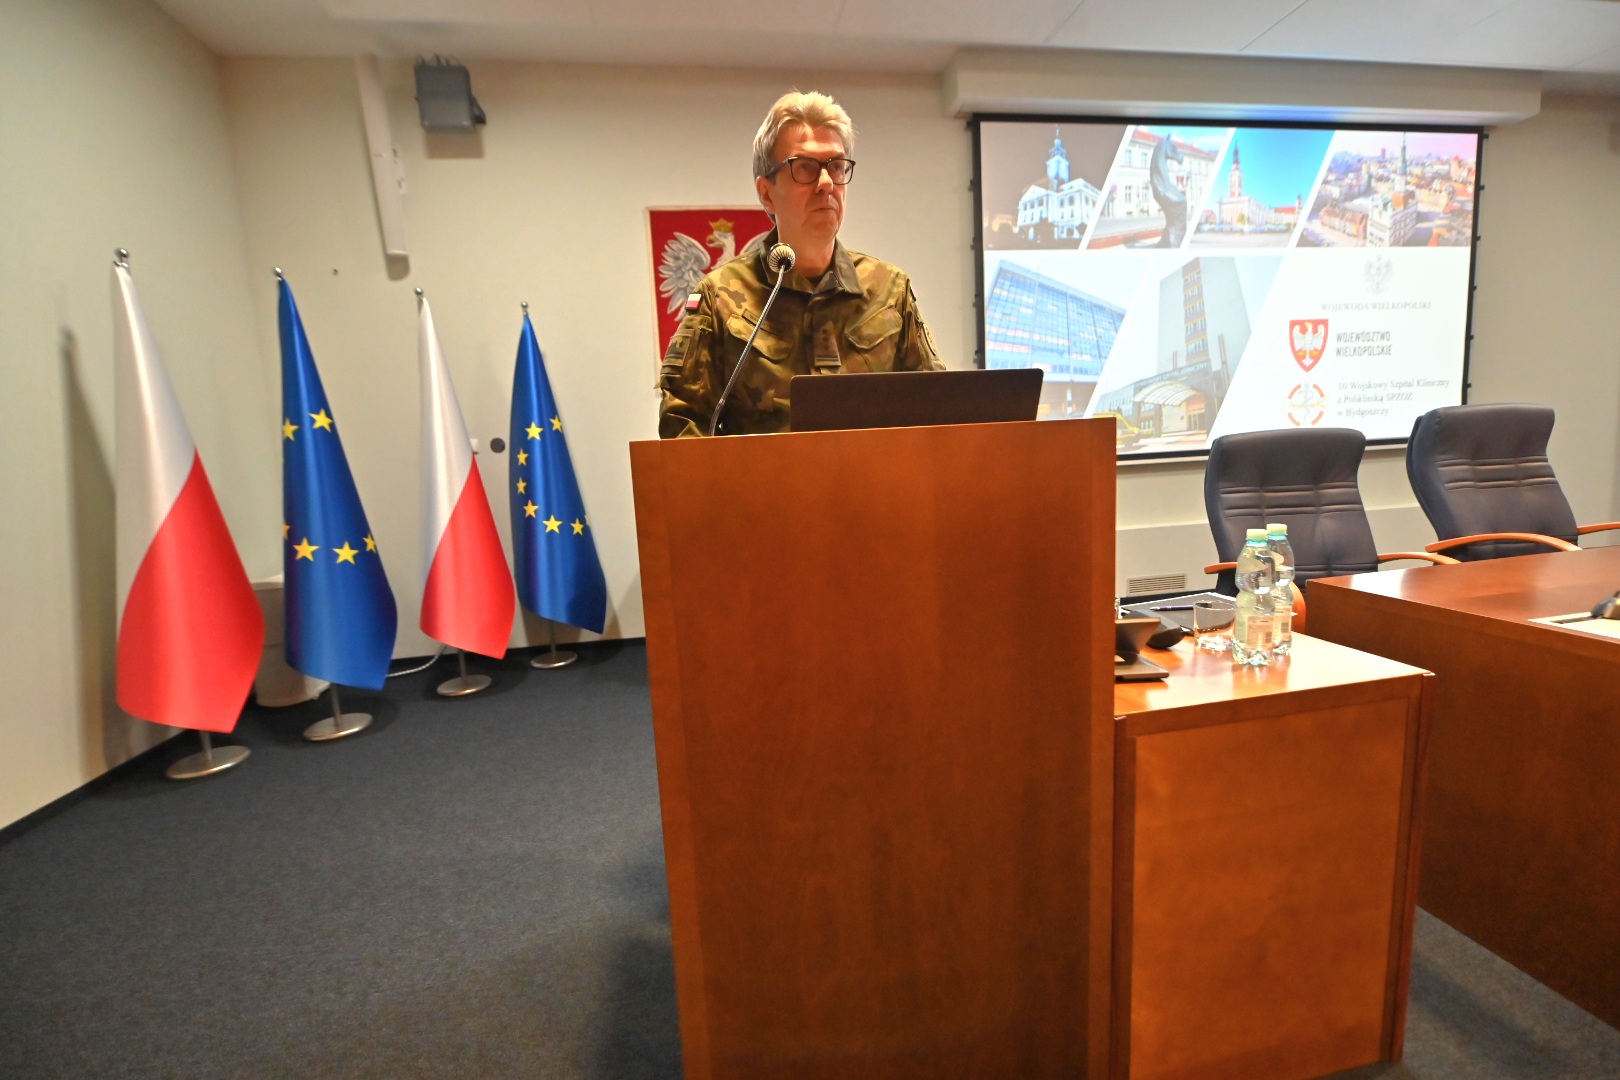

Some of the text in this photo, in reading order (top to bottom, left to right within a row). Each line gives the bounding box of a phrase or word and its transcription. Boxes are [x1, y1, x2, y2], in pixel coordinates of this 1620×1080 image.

[1320, 301, 1432, 313] WOJEWODA WIELKOPOLSKI
[1335, 329, 1391, 343] WOJEWÓDZTWO
[1335, 345, 1393, 357] WIELKOPOLSKIE
[1338, 377, 1450, 392] 10 Wojskowy Szpital Kliniczny
[1345, 406, 1389, 419] Bydgoszczy
